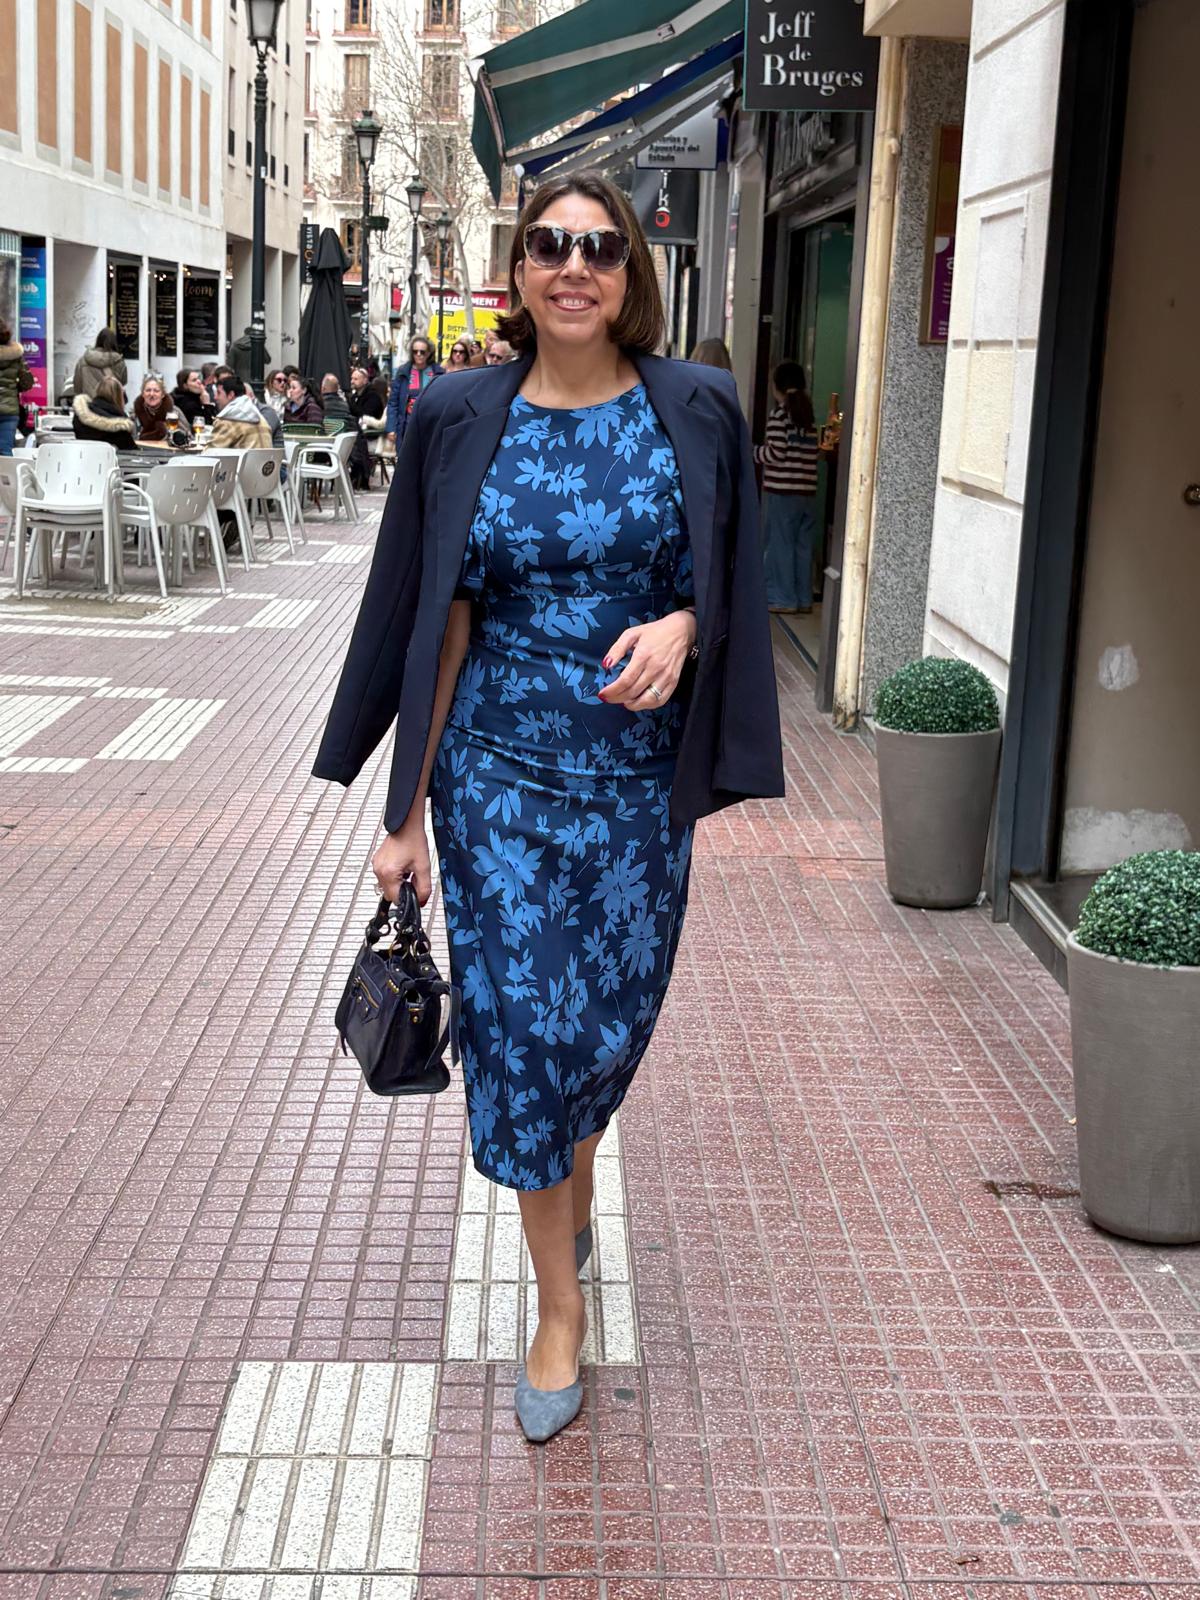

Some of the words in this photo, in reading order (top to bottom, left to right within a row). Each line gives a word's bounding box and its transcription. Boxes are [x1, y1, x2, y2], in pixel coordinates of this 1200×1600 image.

[760, 10, 816, 44] Jeff
[788, 43, 812, 61] de
[760, 53, 864, 97] Bruges
